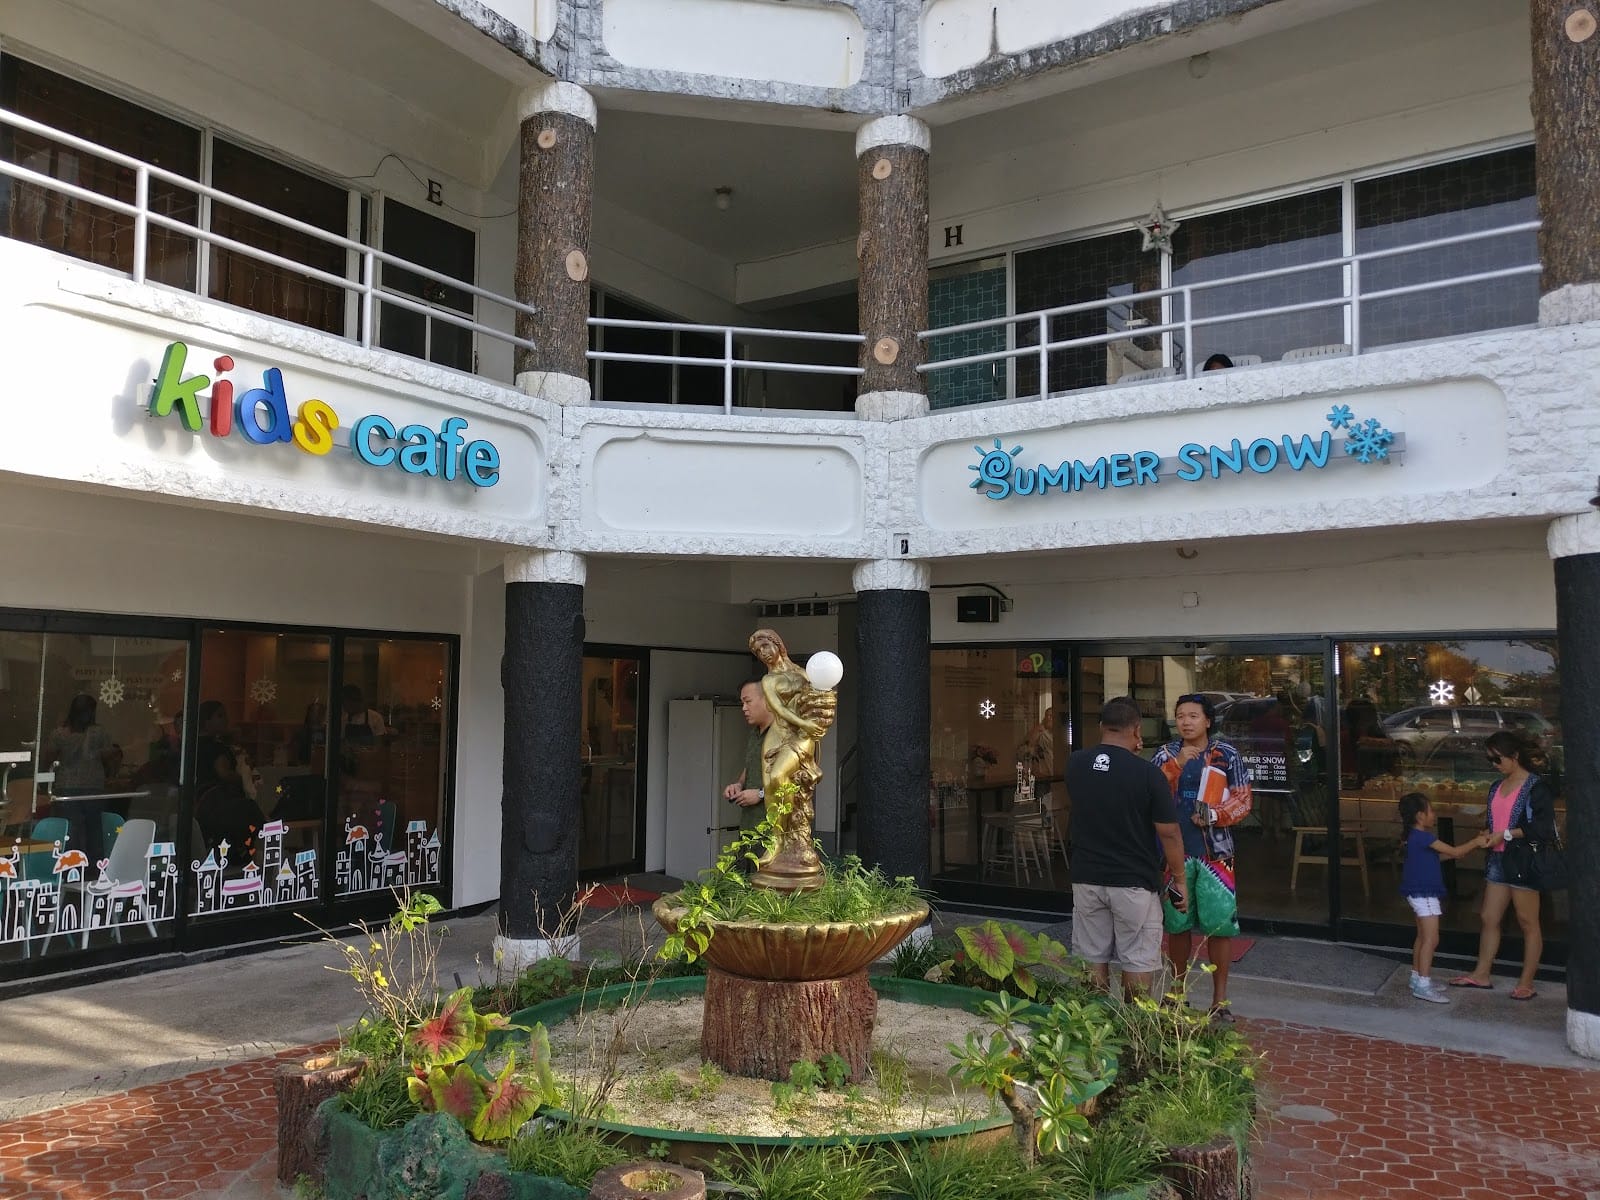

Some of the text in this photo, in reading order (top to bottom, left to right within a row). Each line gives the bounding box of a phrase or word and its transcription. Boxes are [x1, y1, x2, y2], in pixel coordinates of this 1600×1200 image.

[427, 179, 443, 206] E
[944, 225, 963, 247] H
[150, 341, 501, 488] kids cafe
[974, 430, 1332, 500] SUMMER SNOW
[1262, 756, 1286, 764] SNOW
